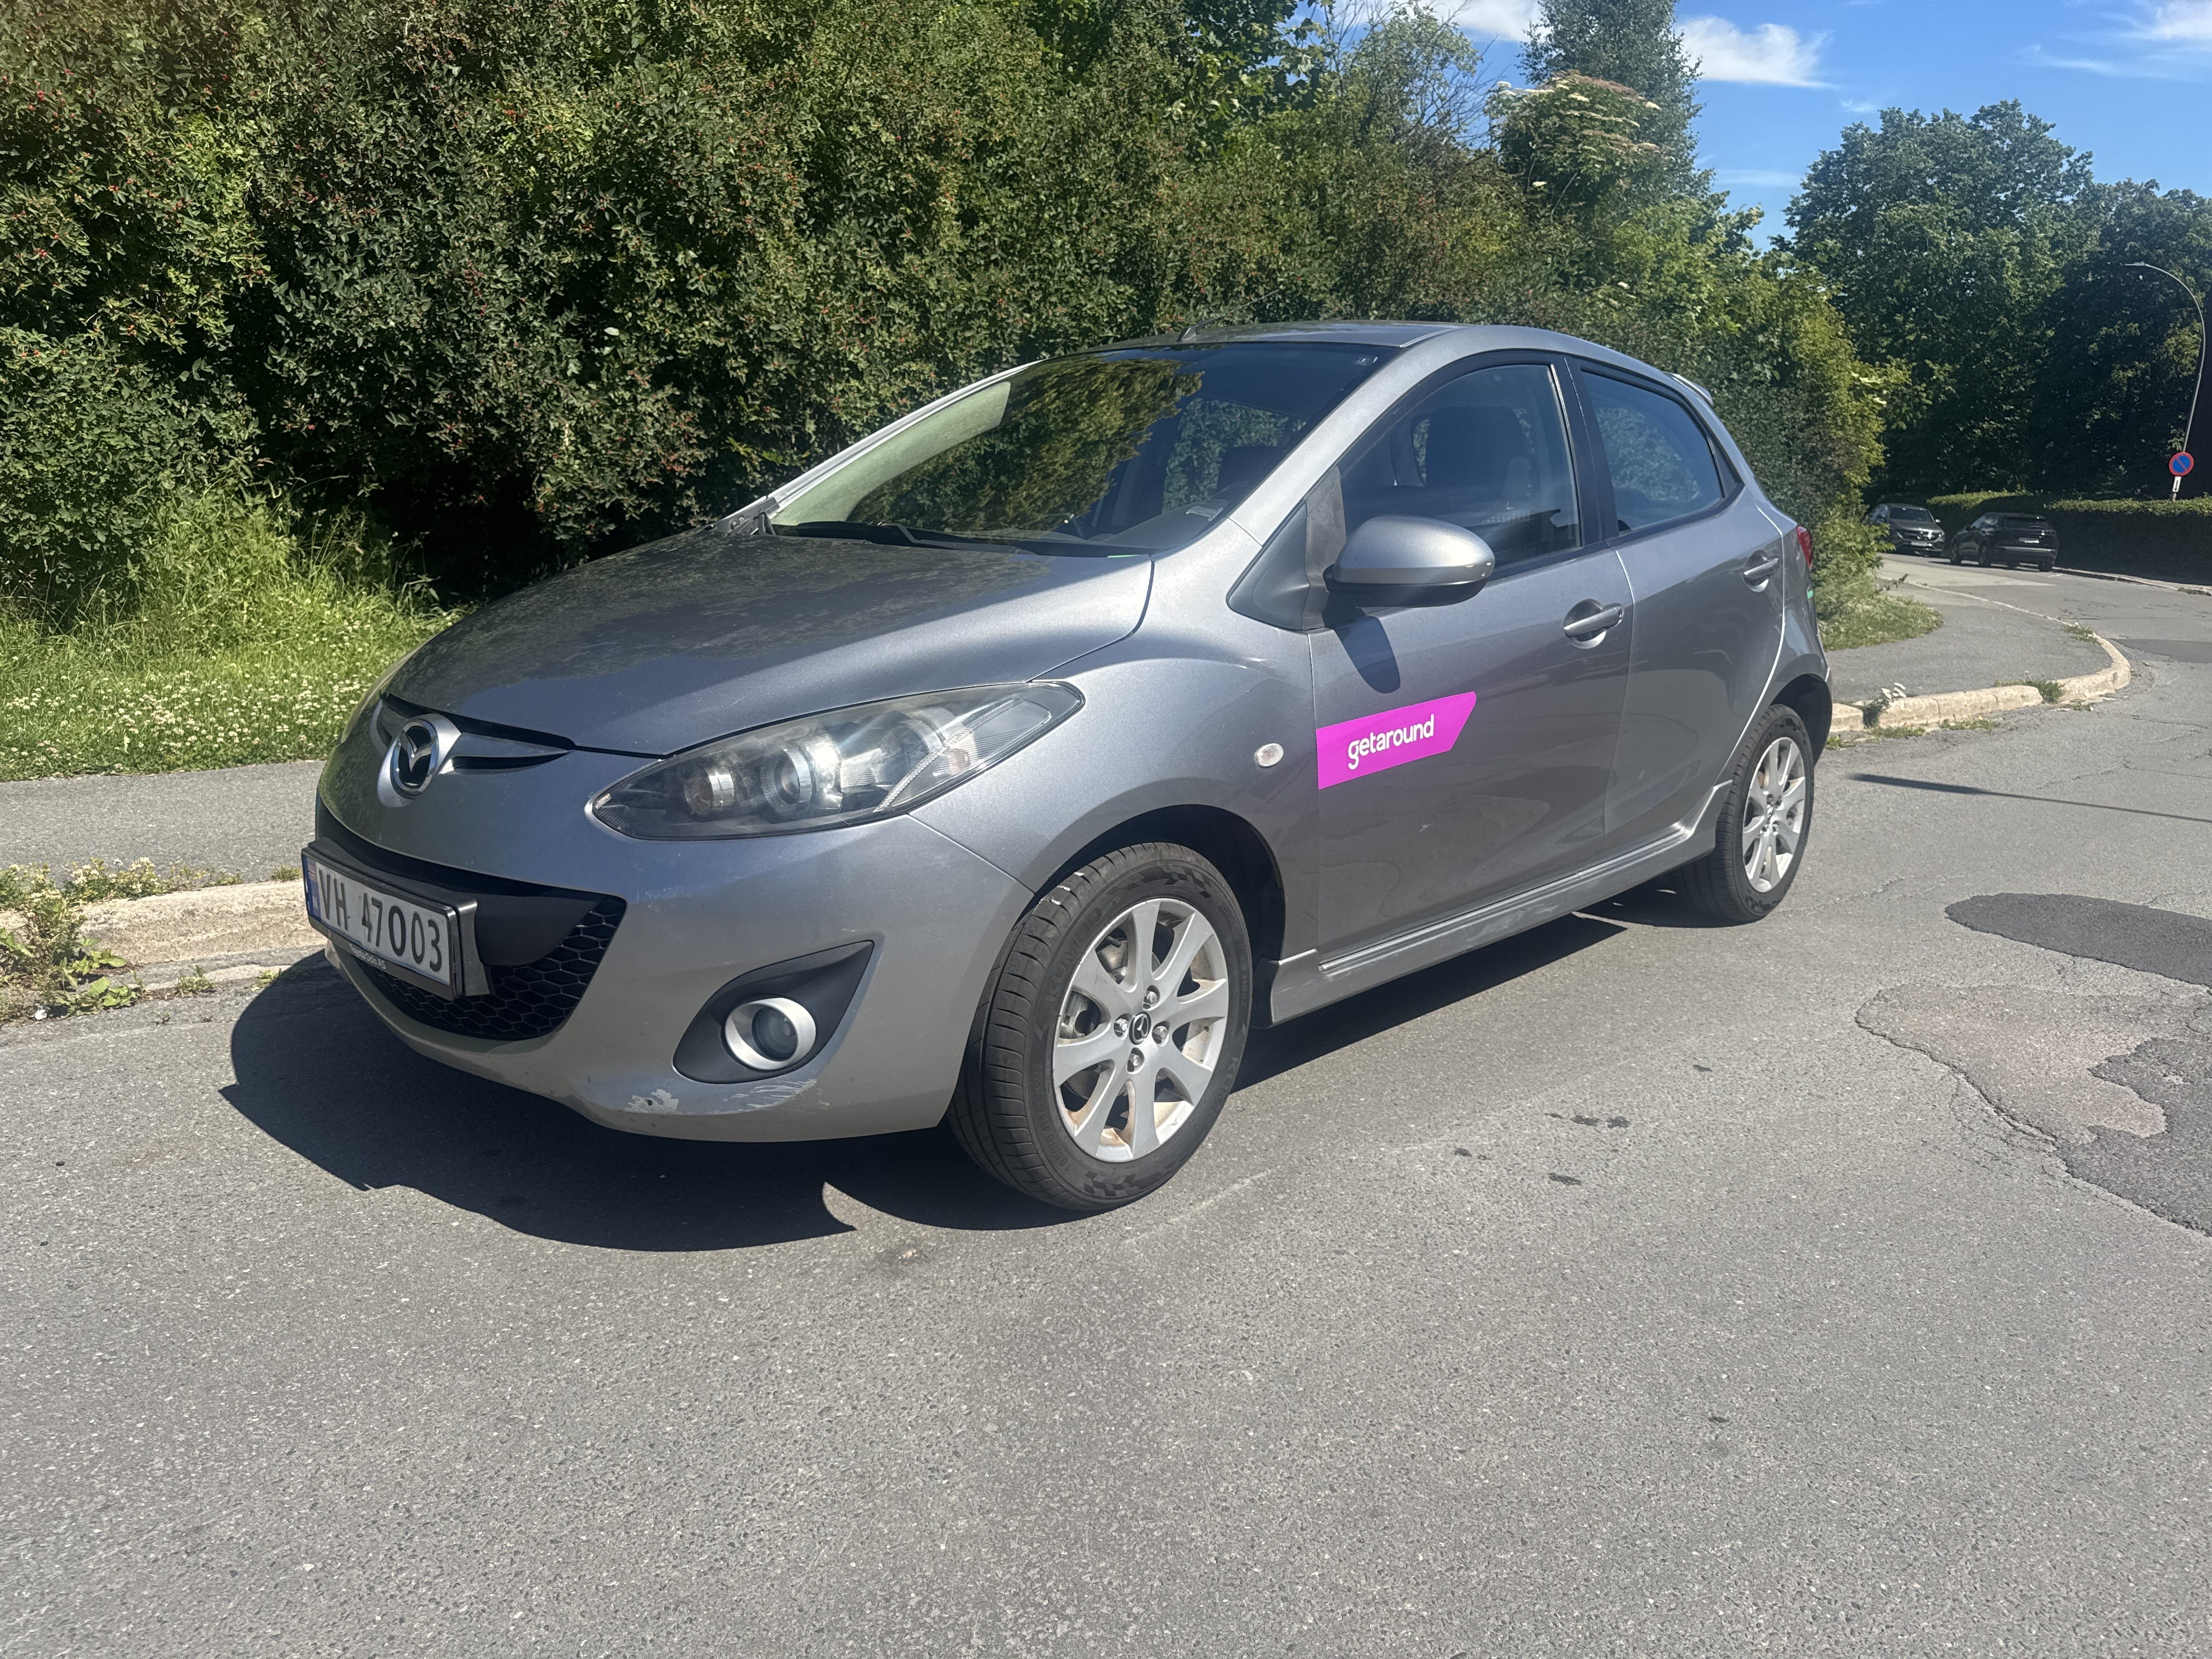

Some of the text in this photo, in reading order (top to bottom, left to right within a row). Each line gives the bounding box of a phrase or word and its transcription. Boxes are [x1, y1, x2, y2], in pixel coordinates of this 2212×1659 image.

[1347, 714, 1435, 770] getaround
[319, 868, 442, 972] VH 47003
[1043, 906, 1102, 1003] KUMHO
[377, 958, 386, 970] AS
